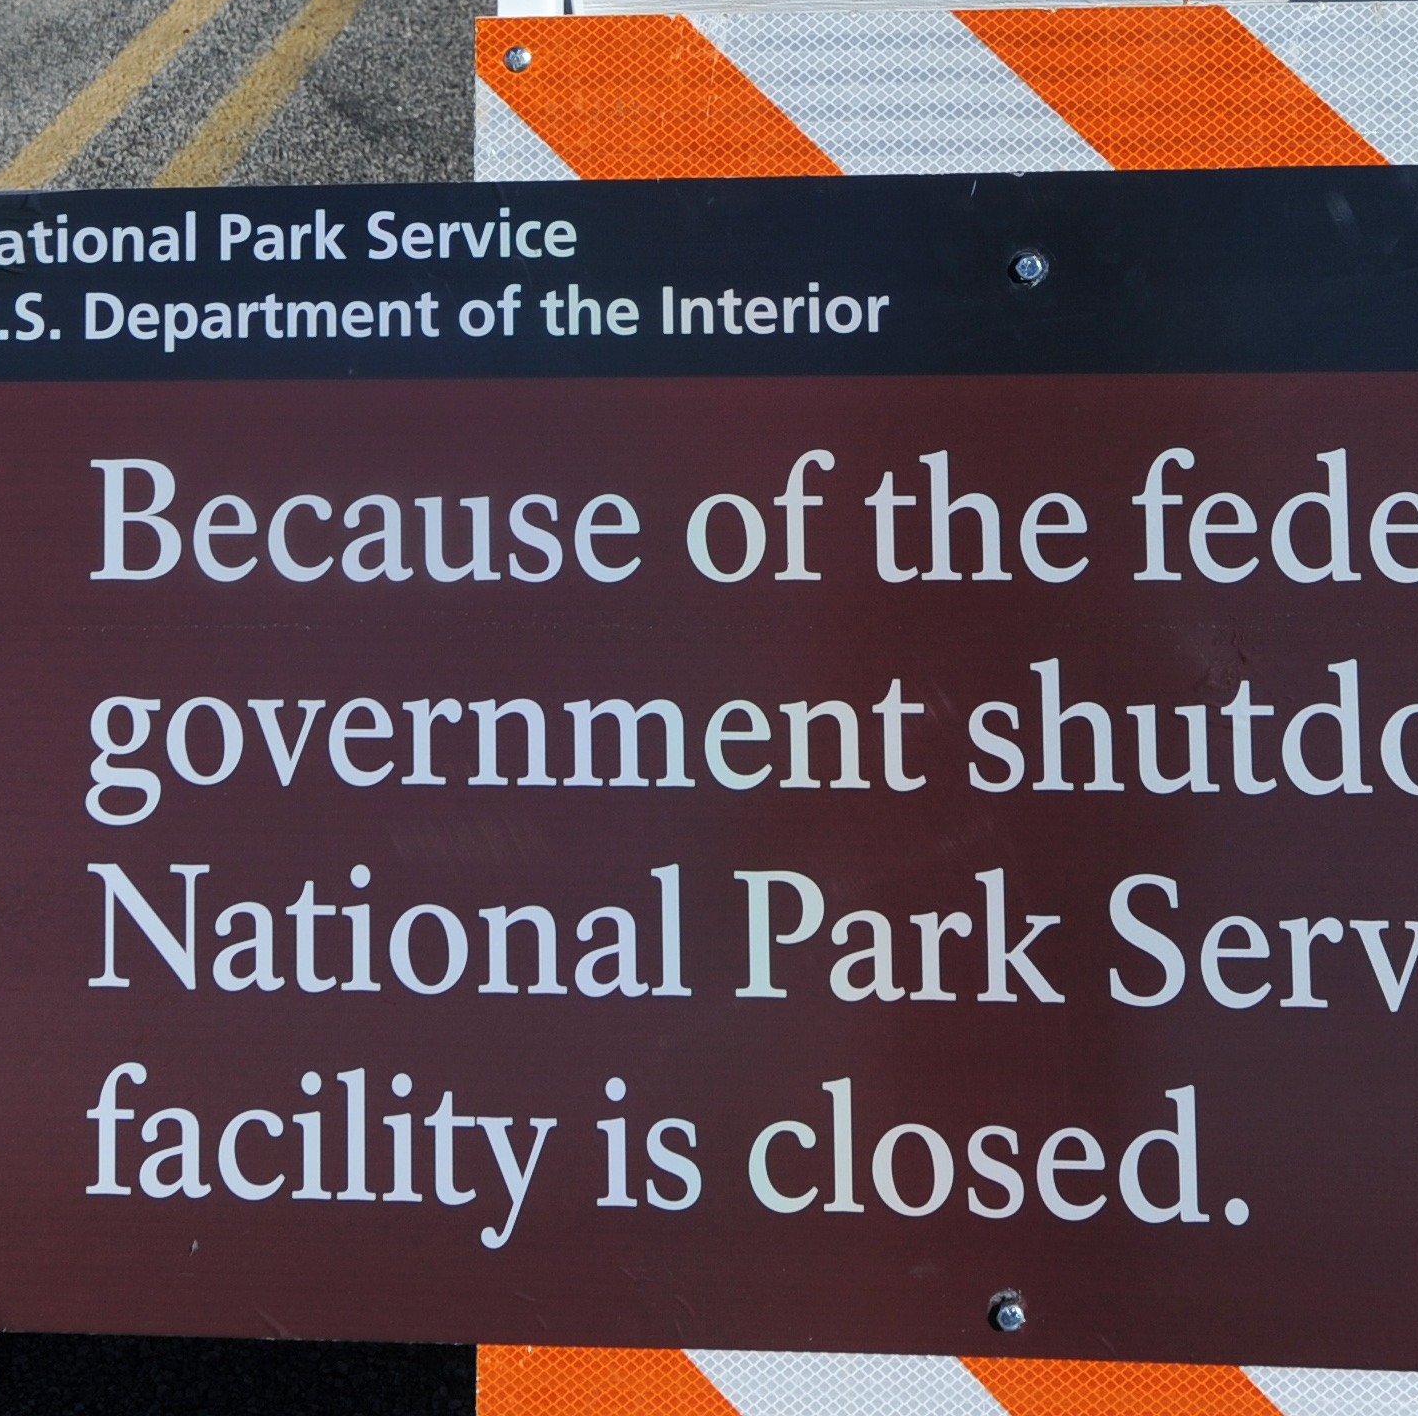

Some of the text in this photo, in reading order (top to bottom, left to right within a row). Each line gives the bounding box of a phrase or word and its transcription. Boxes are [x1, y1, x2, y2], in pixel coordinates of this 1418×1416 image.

[220, 209, 347, 262] Park
[367, 207, 577, 260] Service
[85, 291, 440, 353] Department
[458, 283, 522, 337] of
[539, 283, 640, 337] the
[662, 282, 890, 335] Interior
[89, 458, 642, 583] Because
[686, 449, 837, 586] of
[864, 449, 1090, 583] the
[85, 678, 927, 826] government
[87, 862, 692, 998] National
[733, 867, 1066, 1004] Park
[85, 1061, 1253, 1249] facility is closed.
